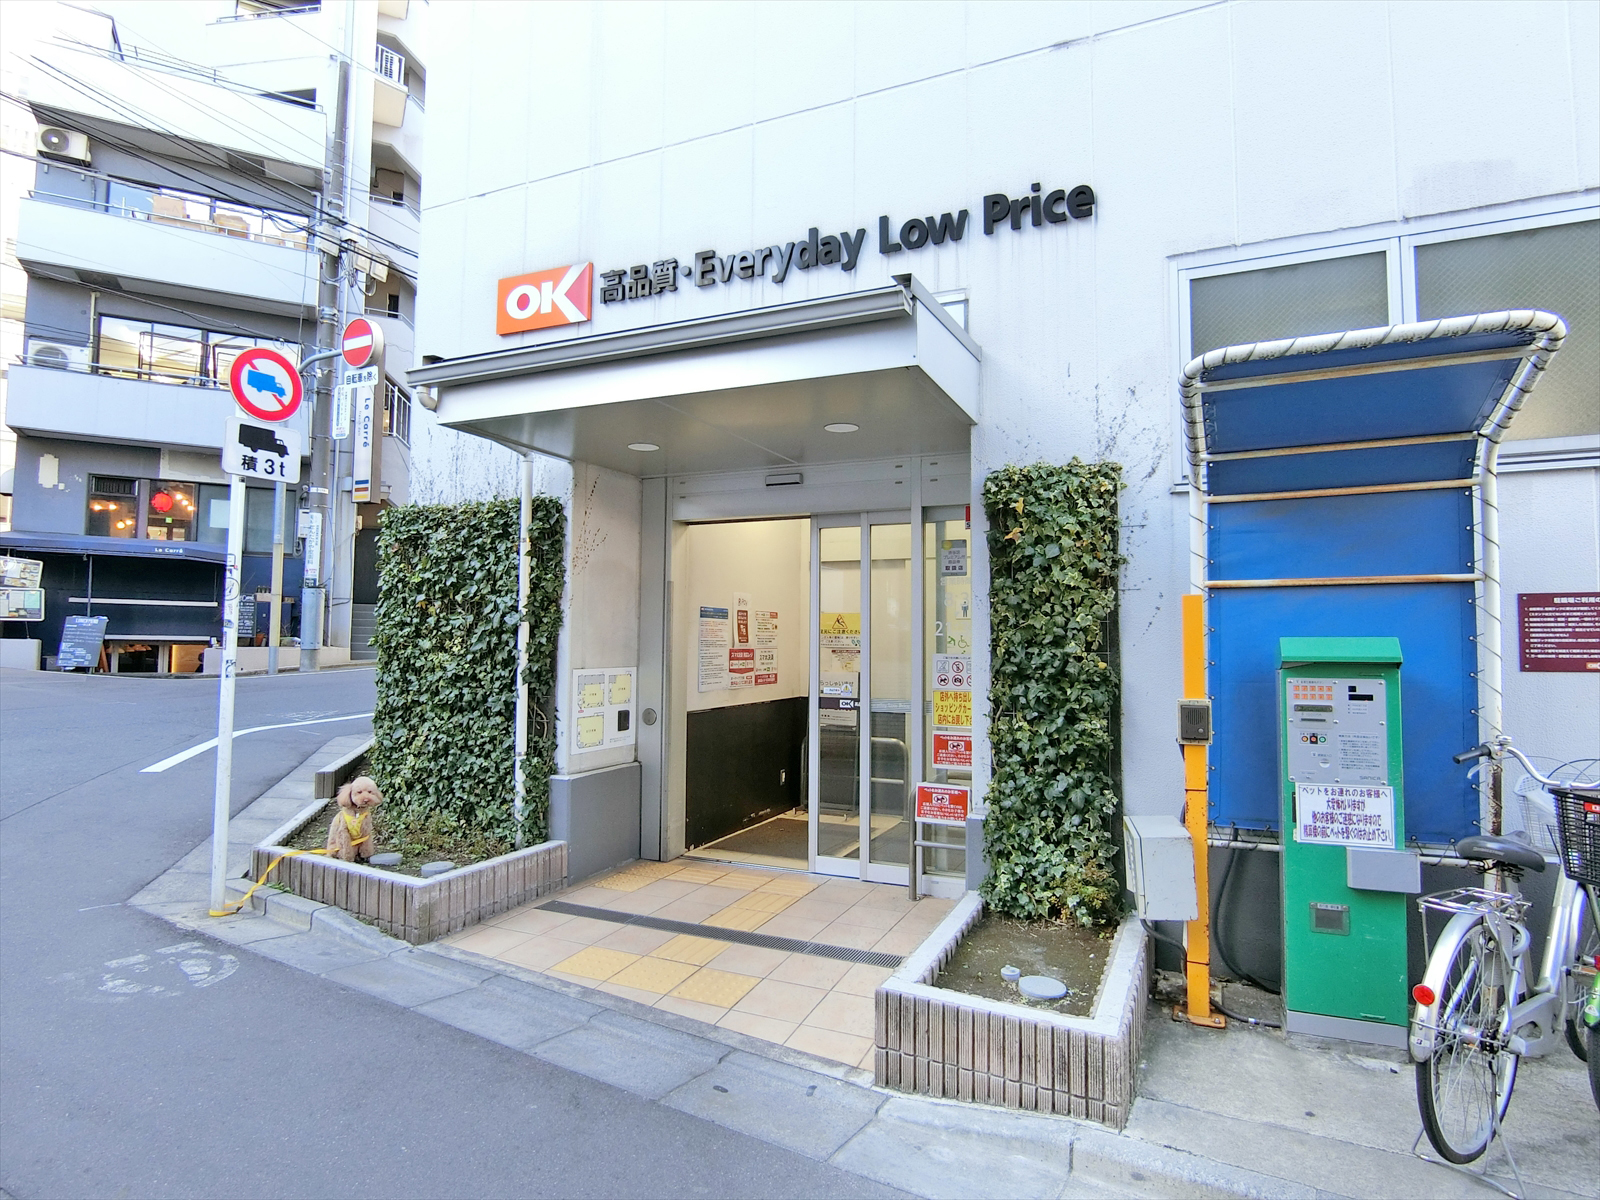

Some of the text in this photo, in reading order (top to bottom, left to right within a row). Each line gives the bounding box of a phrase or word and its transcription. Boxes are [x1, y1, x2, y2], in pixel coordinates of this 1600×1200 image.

[879, 209, 968, 254] Low
[983, 182, 1095, 235] Price
[506, 262, 588, 322] OK
[362, 397, 371, 448] Le Carré
[841, 700, 854, 708] OK
[940, 692, 971, 702] 店外へ持ち出し
